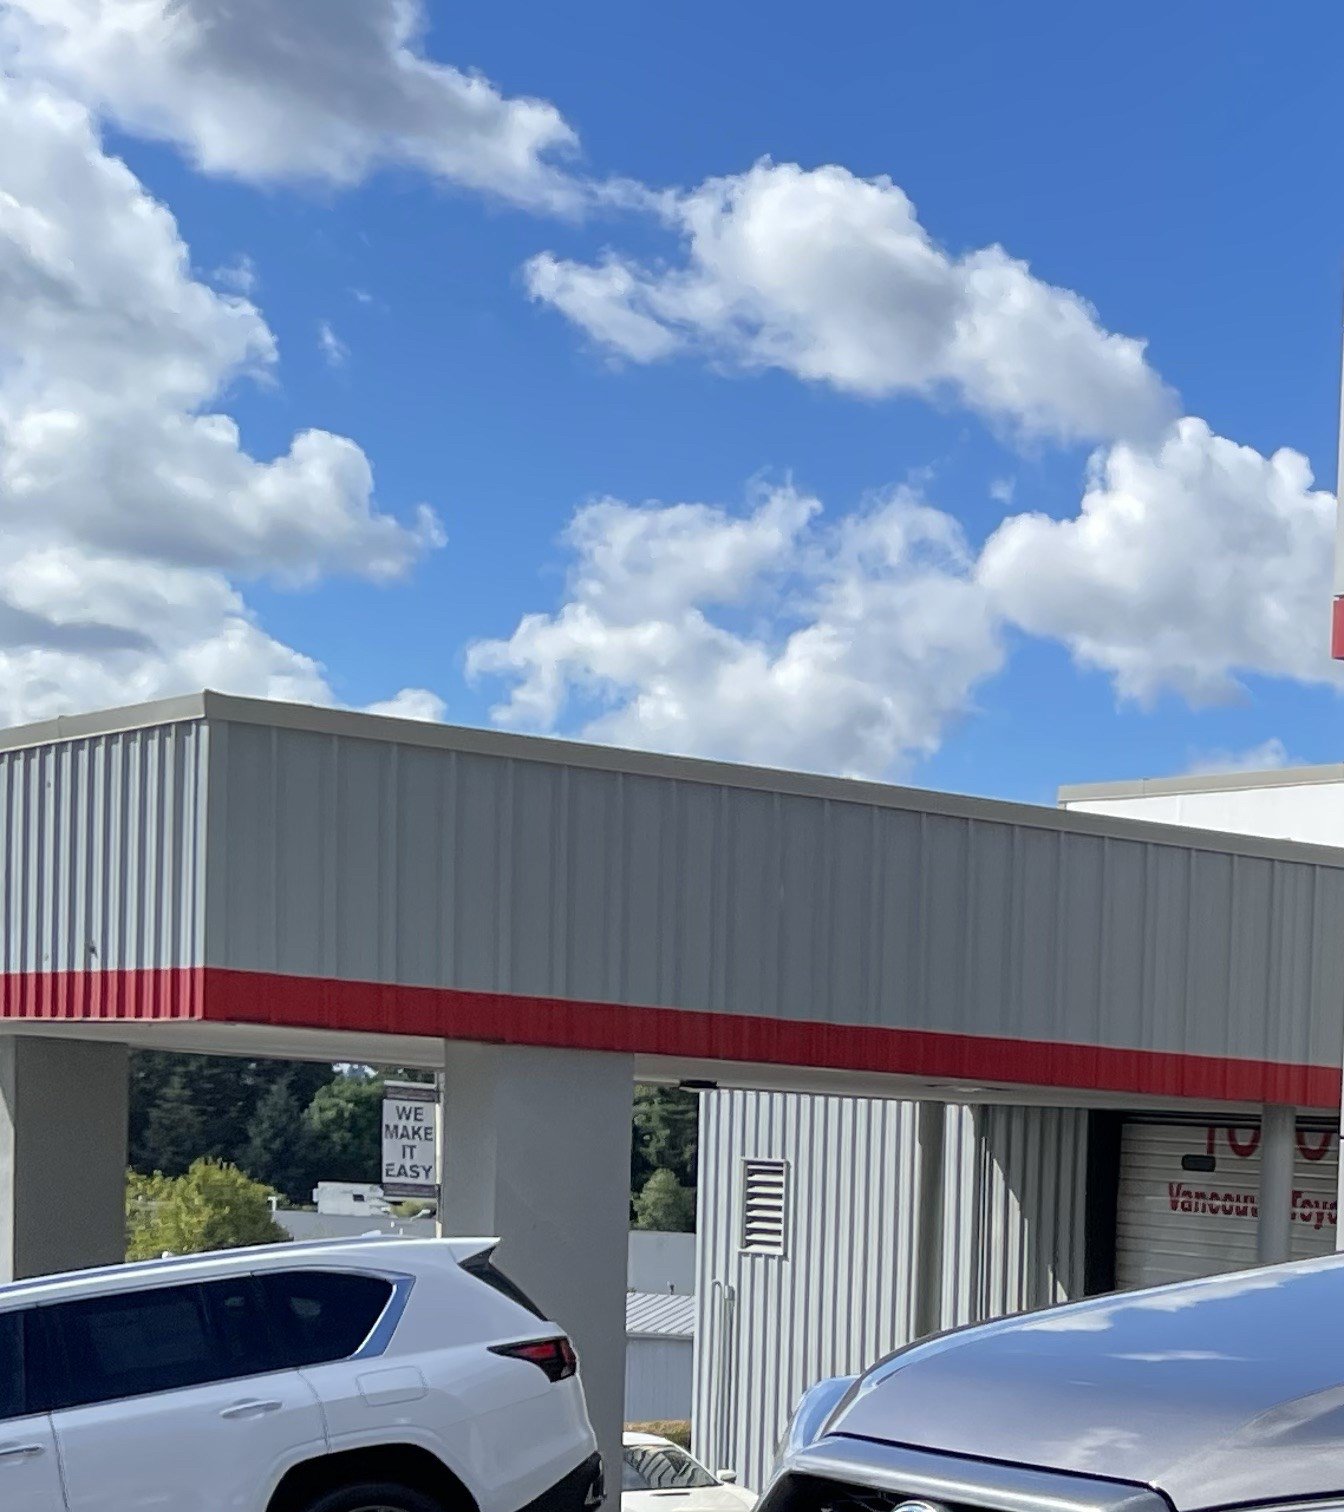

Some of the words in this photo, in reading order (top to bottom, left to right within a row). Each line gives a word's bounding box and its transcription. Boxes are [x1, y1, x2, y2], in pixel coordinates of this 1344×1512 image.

[395, 1105, 424, 1122] WE
[384, 1124, 433, 1141] MAKE
[402, 1144, 417, 1160] IT
[385, 1162, 433, 1180] EASY
